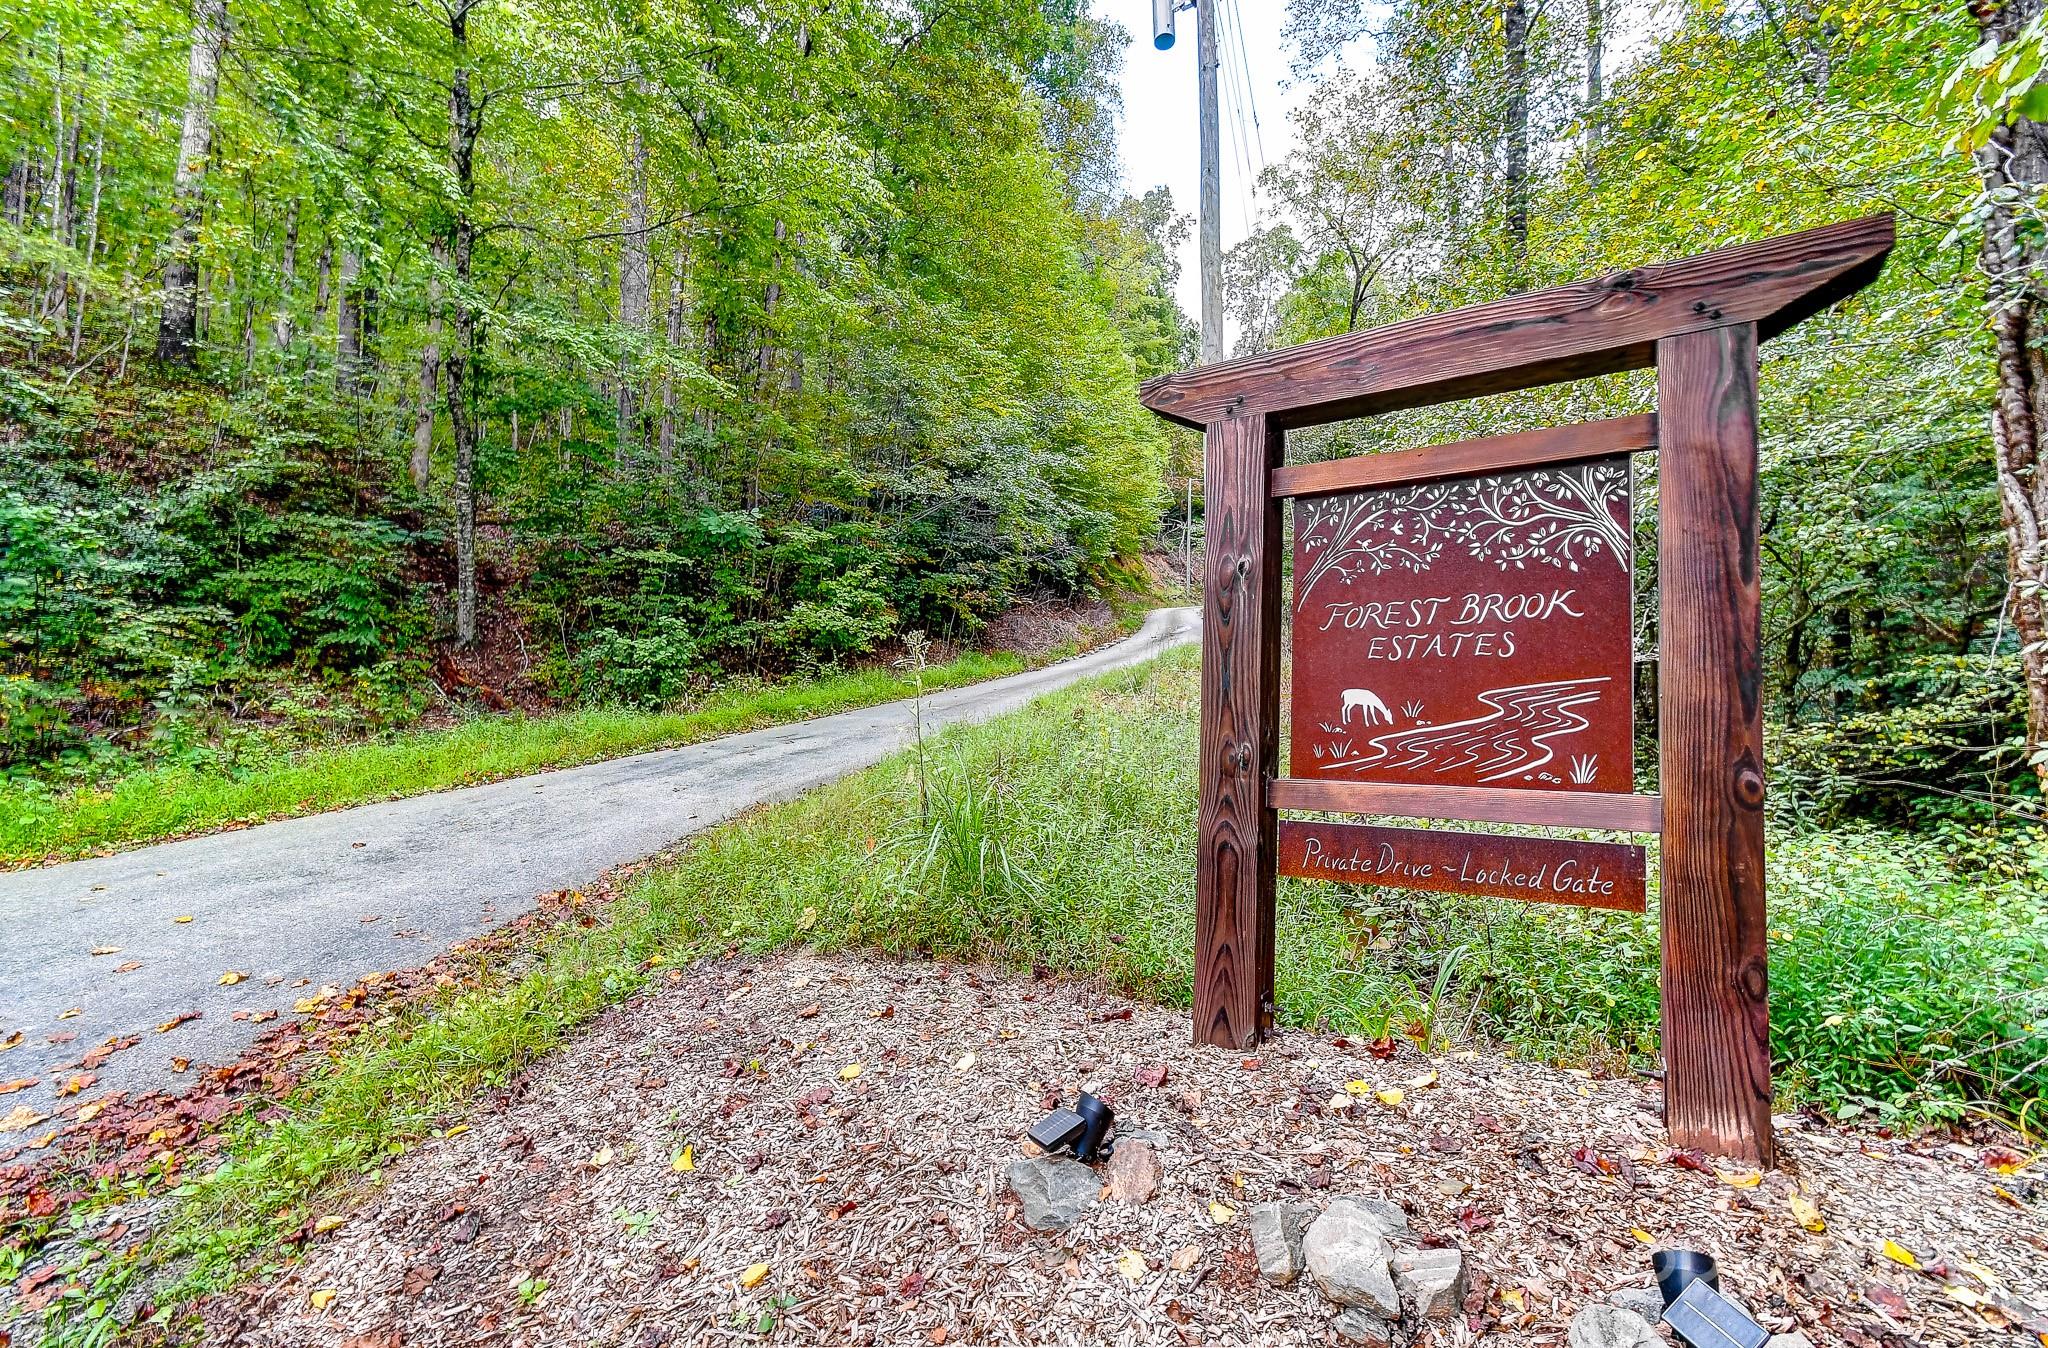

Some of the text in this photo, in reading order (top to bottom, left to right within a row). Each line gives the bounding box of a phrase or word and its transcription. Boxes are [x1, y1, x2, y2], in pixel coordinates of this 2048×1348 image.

[1319, 589, 1584, 631] FOREST BROOK
[1367, 631, 1516, 661] ESTATES
[1301, 838, 1373, 872] Private
[1376, 843, 1432, 878] Drive
[1459, 851, 1547, 890] Locked
[1552, 859, 1615, 895] Gate
